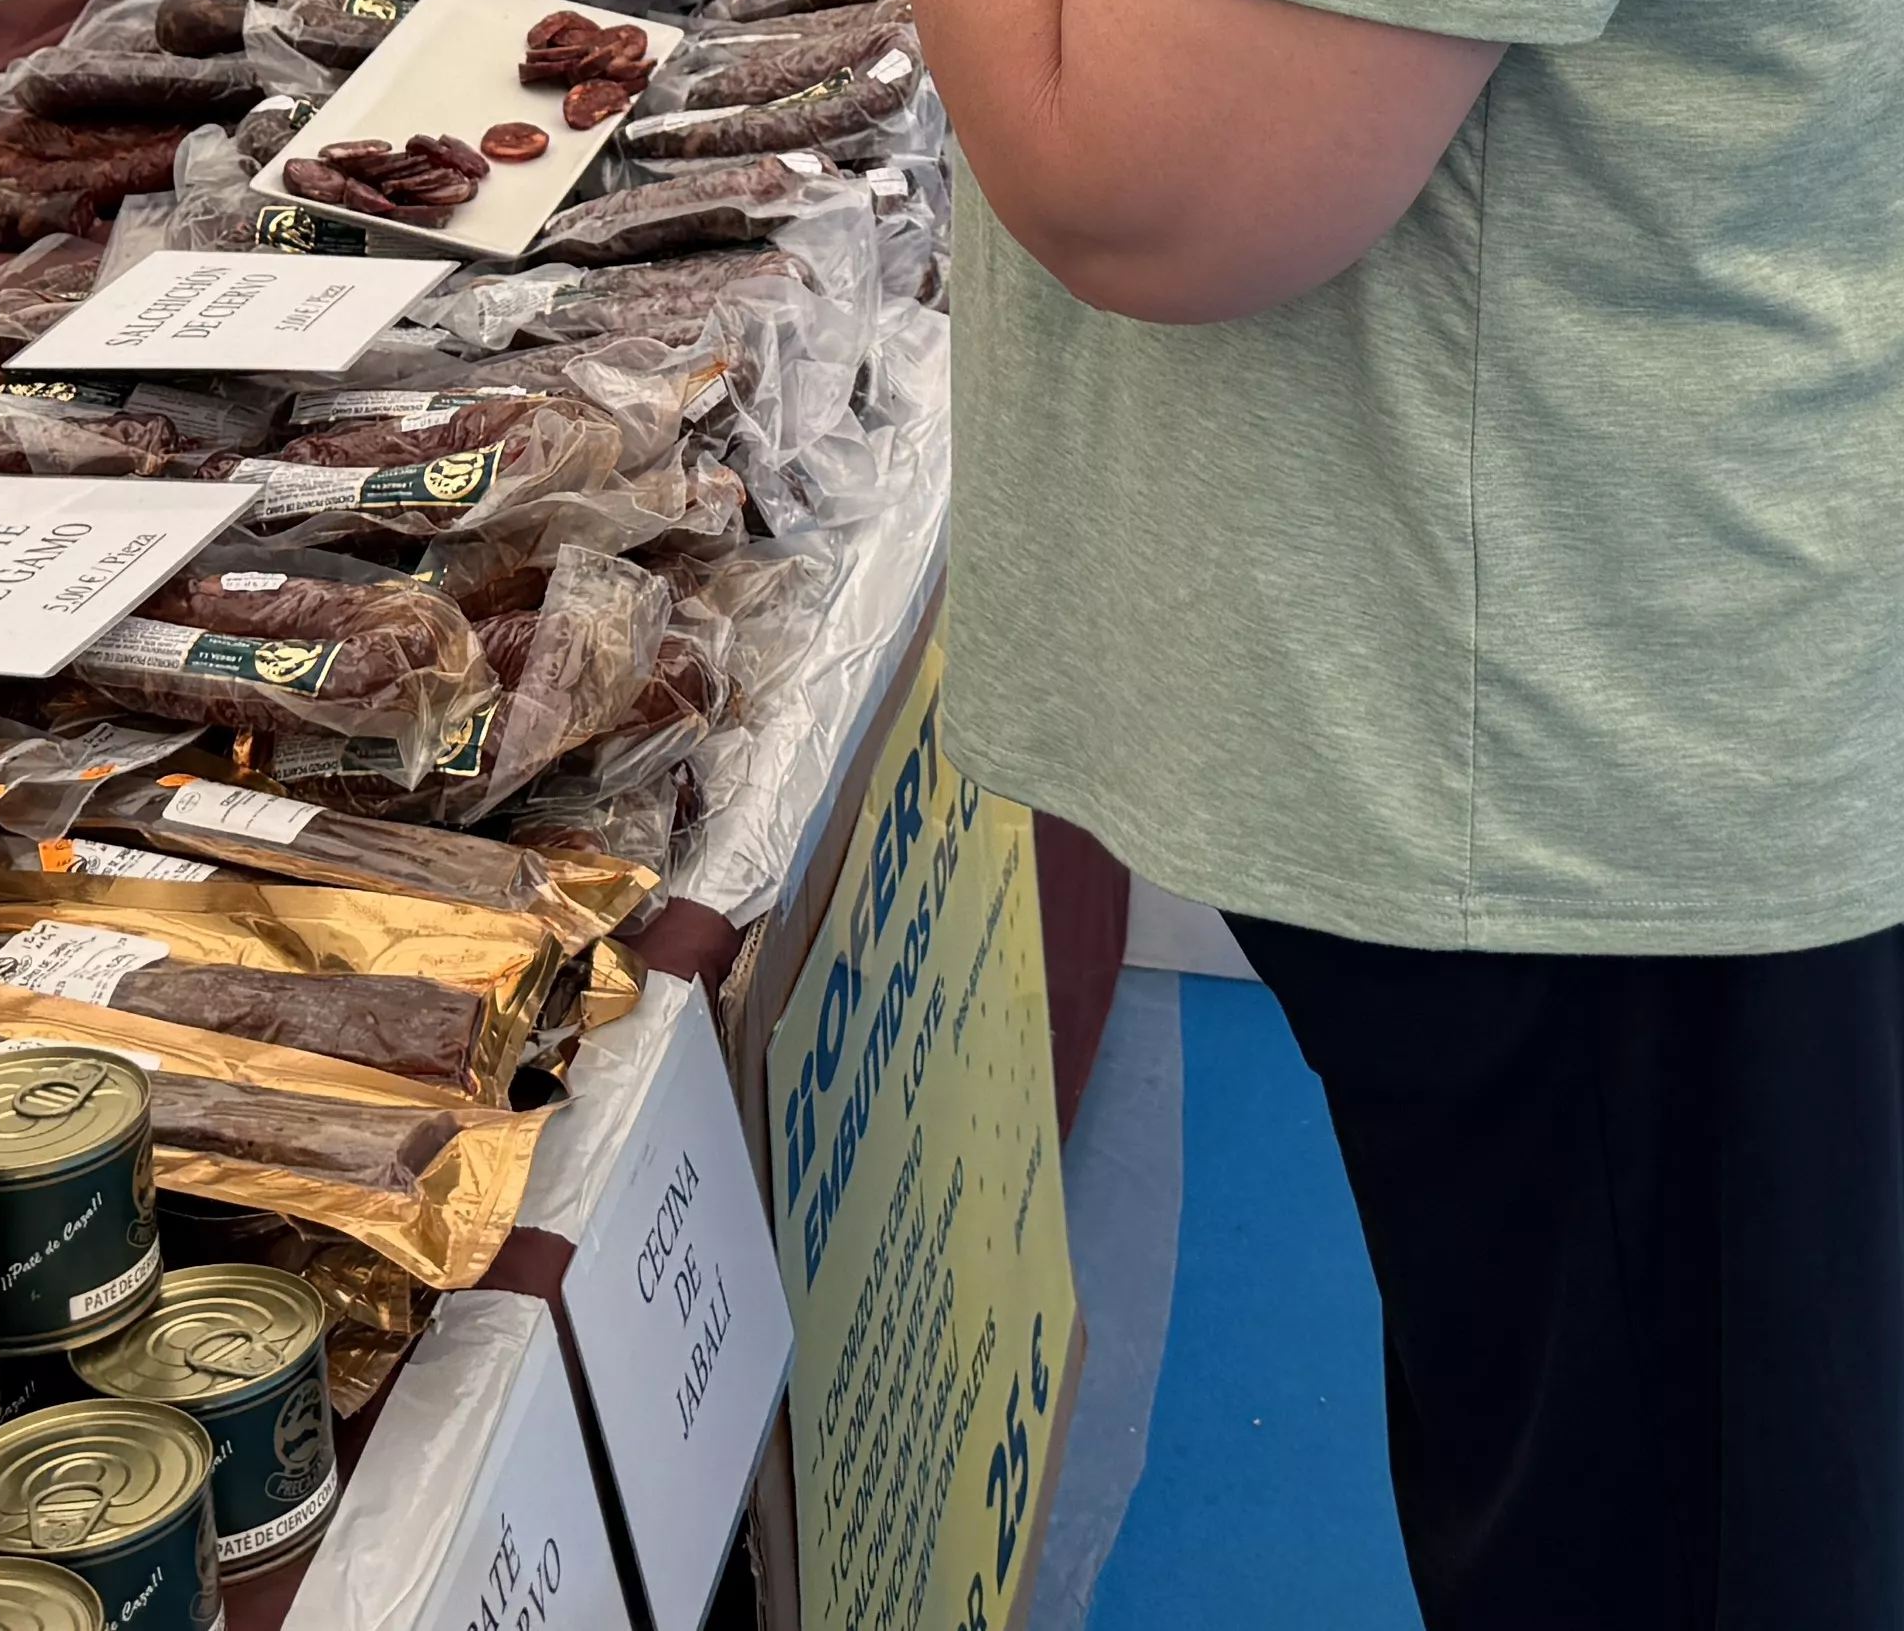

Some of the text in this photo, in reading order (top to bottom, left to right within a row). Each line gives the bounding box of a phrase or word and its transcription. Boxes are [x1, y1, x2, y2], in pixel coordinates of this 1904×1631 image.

[106, 266, 232, 346] SALCHICHÓN
[172, 273, 277, 338] DE CIERVO
[98, 533, 157, 564] Pieza
[785, 678, 941, 1218] ¡¡OFERT
[805, 799, 958, 1294] EMBUTIDOS DE
[45, 1240, 60, 1255] de
[84, 1274, 133, 1312] PATÉ DE
[637, 1150, 699, 1304] CECINA
[673, 1243, 702, 1327] DE
[826, 1124, 923, 1436] CHORIZO DE CIERVO
[676, 1263, 732, 1440] JABALÍ
[833, 1344, 881, 1509] CHORIZO
[881, 1294, 896, 1365] DE
[840, 1155, 963, 1580] CHORIZO PICANTE DE GAMO
[912, 1370, 924, 1438] DE
[923, 1273, 954, 1391] CIERVO
[935, 1450, 956, 1520] CON
[954, 1305, 996, 1454] BOLETUS
[216, 1534, 253, 1557] PATÉ
[255, 1527, 274, 1547] DE
[276, 1500, 316, 1539] CIERVO
[987, 1370, 1029, 1596] 25
[467, 1512, 521, 1631] ATÉ
